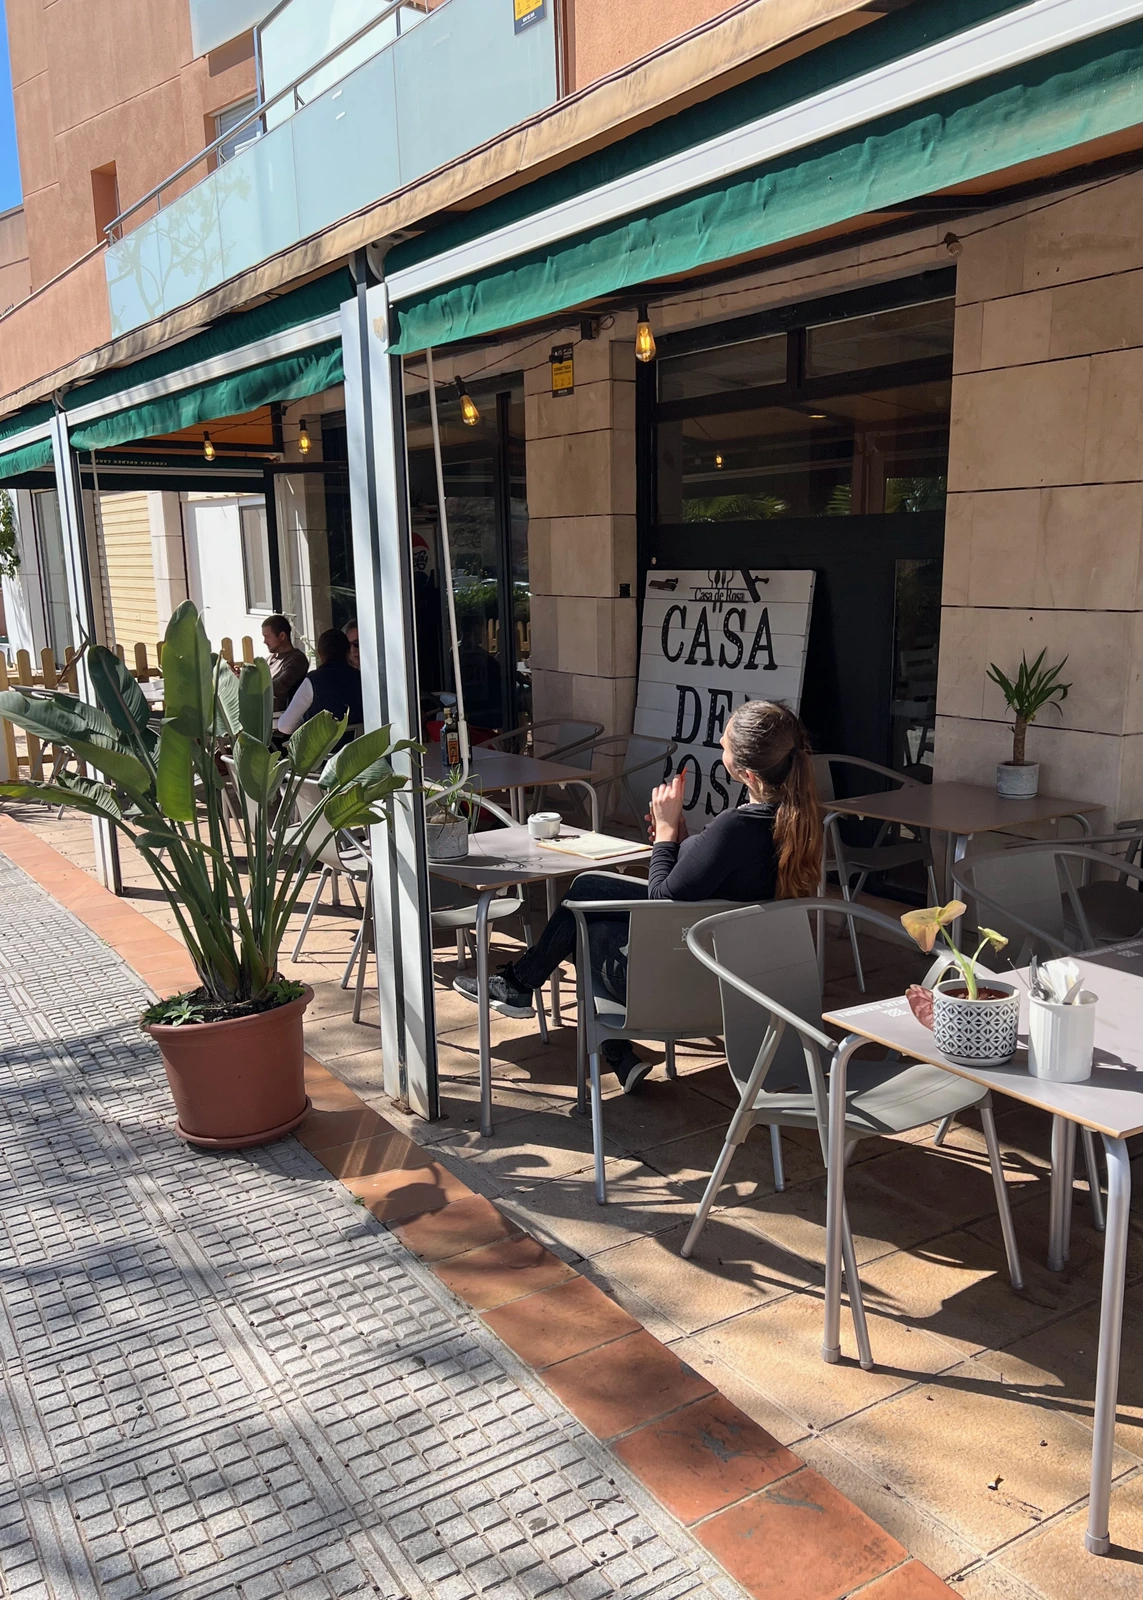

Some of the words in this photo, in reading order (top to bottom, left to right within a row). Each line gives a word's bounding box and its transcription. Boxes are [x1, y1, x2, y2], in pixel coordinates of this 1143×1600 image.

[694, 588, 713, 601] Casa
[714, 588, 724, 601] de
[726, 588, 745, 602] Rosa
[661, 604, 778, 670] CASA
[671, 684, 750, 750] DE
[663, 753, 750, 817] OS
